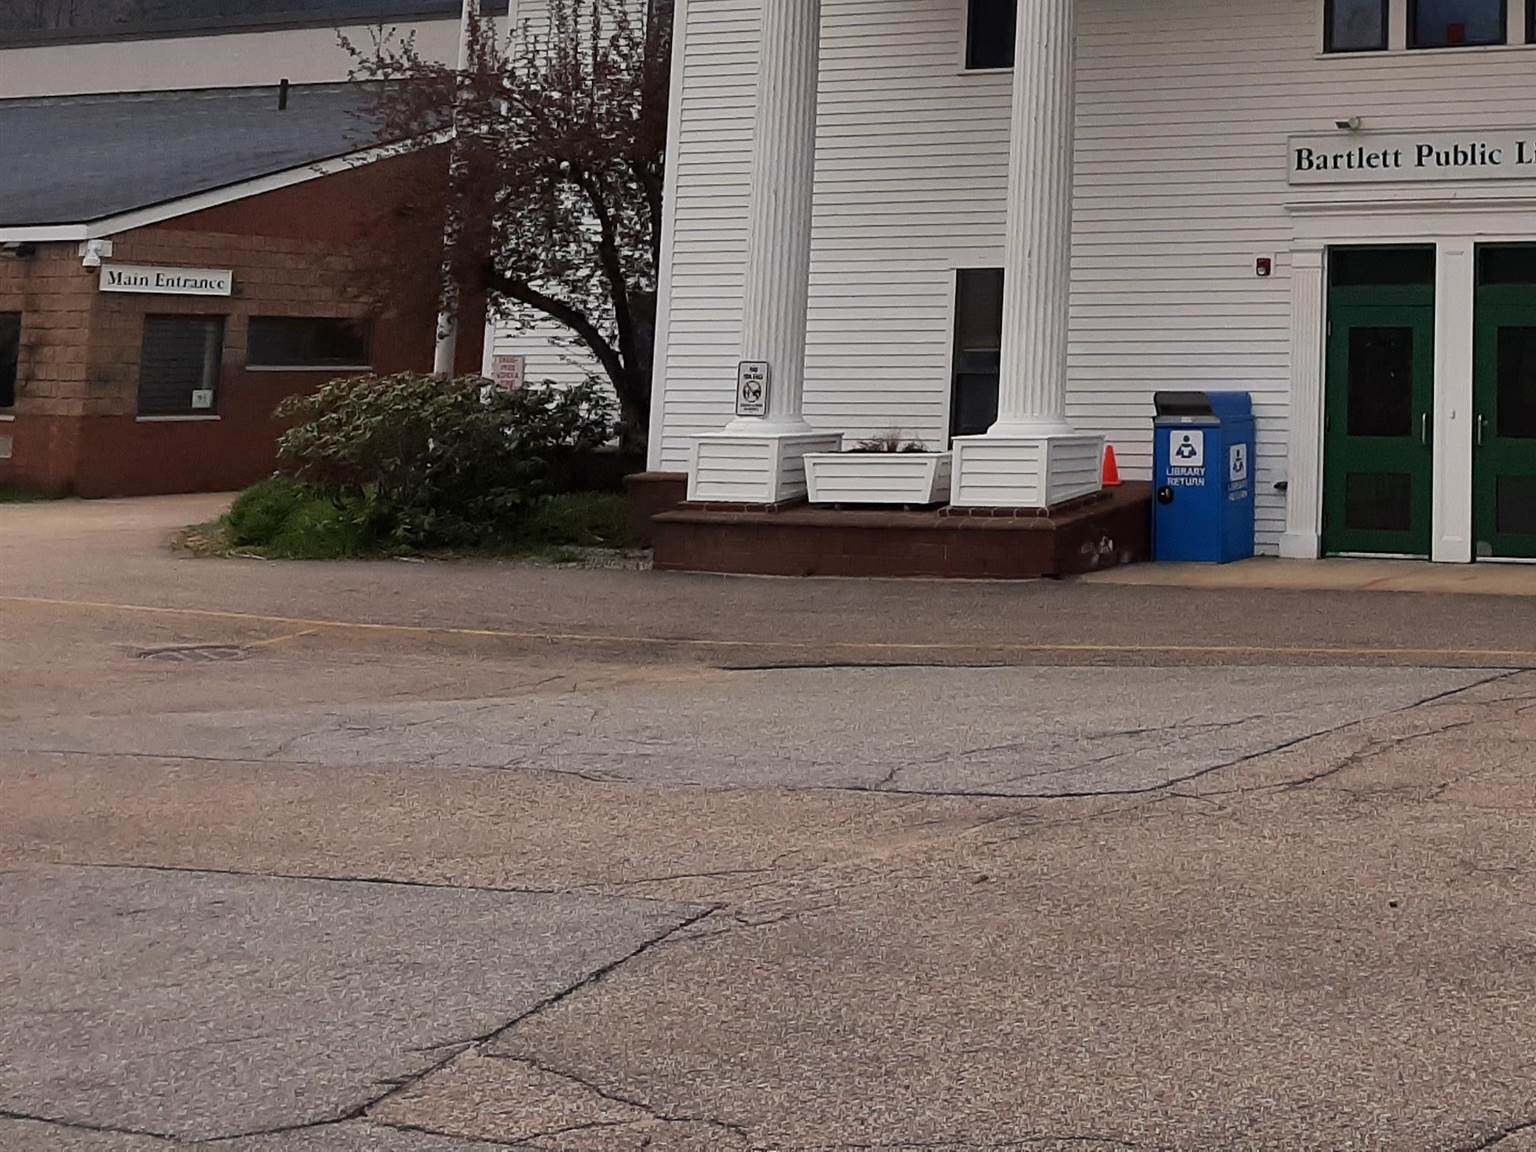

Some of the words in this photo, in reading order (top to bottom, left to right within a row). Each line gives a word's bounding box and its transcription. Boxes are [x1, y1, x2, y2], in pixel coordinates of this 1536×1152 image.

[1295, 147, 1402, 171] Bartlett
[1415, 143, 1502, 168] Public
[107, 271, 149, 287] Main
[155, 272, 225, 290] Entrance
[1166, 467, 1206, 476] LIBRARY
[1167, 477, 1205, 486] RETURN
